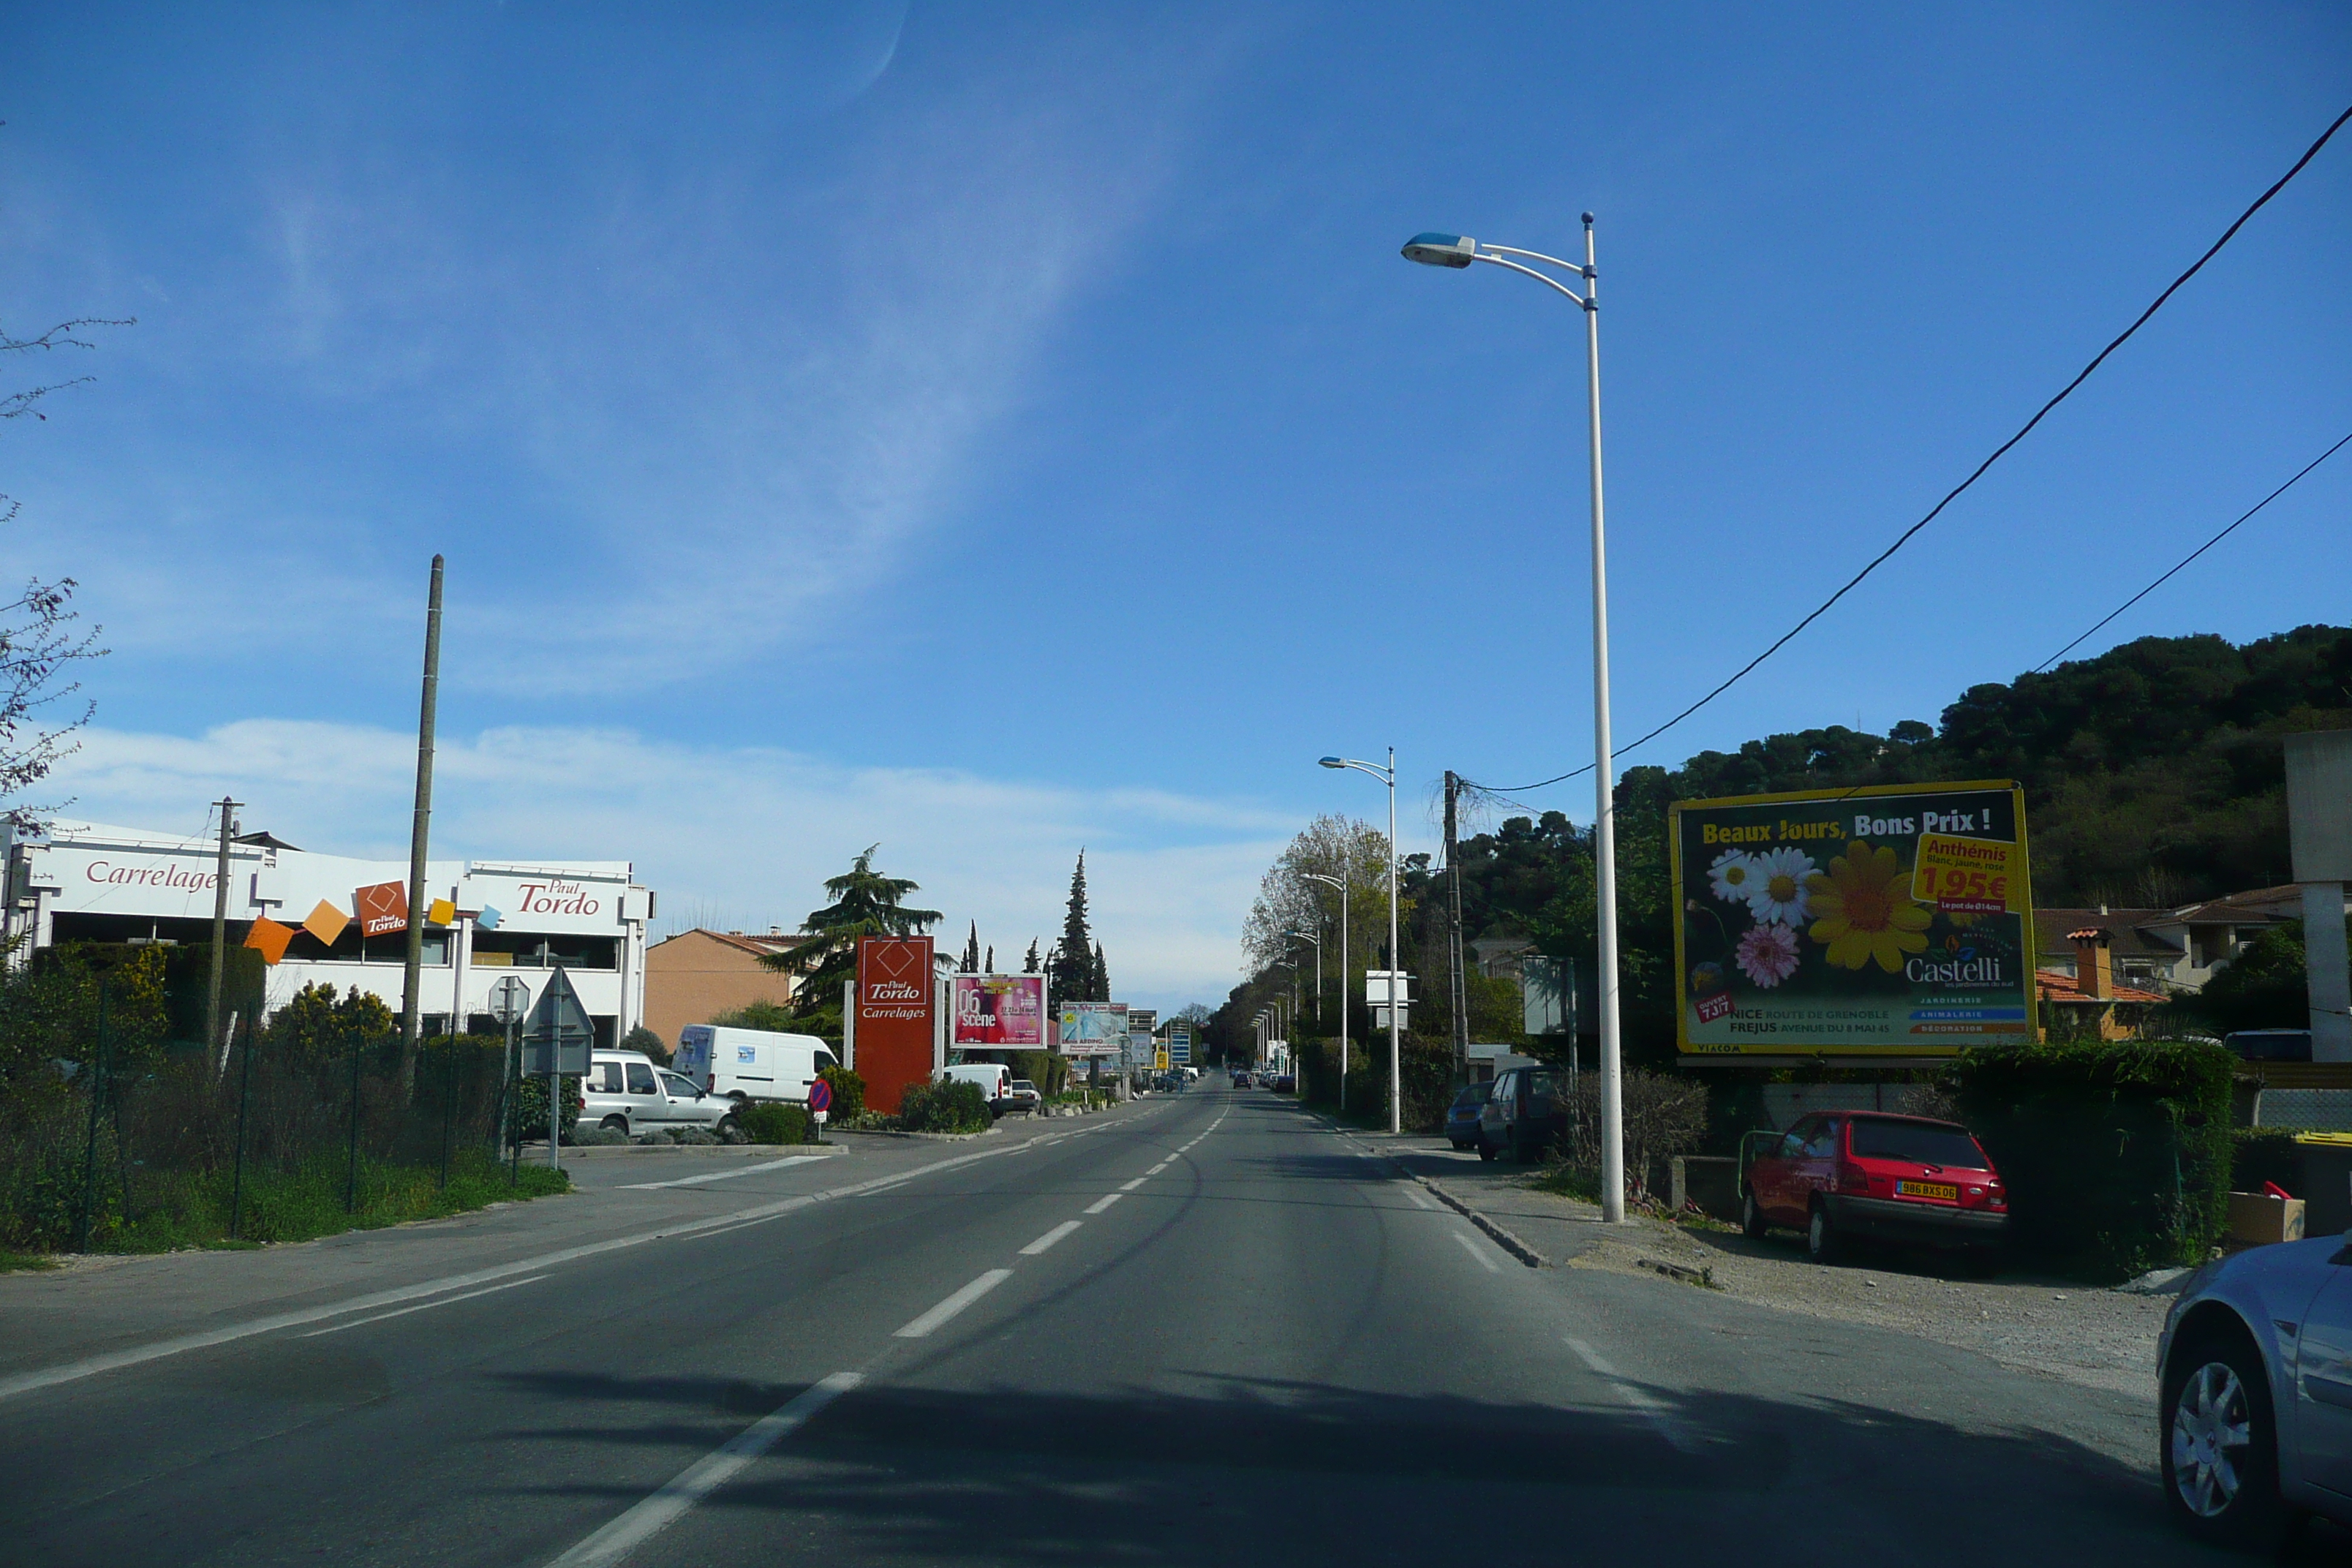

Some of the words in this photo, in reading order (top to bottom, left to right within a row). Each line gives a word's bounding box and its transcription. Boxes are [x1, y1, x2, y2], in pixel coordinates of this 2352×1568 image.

[1703, 823, 1771, 844] Beaux
[1779, 819, 1847, 840] Jours,
[1855, 815, 1915, 837] Bons
[1923, 810, 1975, 834] Prix
[1928, 840, 2007, 862] Anthémis
[1927, 854, 1953, 866] Blanc,
[1955, 859, 1983, 870] jaune,
[1985, 863, 2005, 871] rose
[549, 879, 581, 894] Paul
[1922, 866, 2008, 899] 1,95€
[516, 883, 600, 916] Tordo
[1951, 902, 1964, 911] pot
[367, 918, 406, 933] Tordo
[380, 914, 396, 923] Paul
[1906, 957, 2002, 983] Castelli
[870, 984, 920, 999] Tordo
[888, 981, 907, 989] Paul
[959, 989, 981, 1013] 06
[1699, 995, 1727, 1011] OUVERT
[863, 1007, 926, 1020] Carrelages
[1730, 1009, 1763, 1019] NICE
[1766, 1010, 1804, 1019] ROUTE
[1808, 1011, 1823, 1019] DE
[1826, 1010, 1889, 1019] GRENOBLE
[1730, 1022, 1777, 1035] FREJUS
[1780, 1024, 1825, 1033] AVENUE
[1828, 1025, 1844, 1033] DU
[1855, 1025, 1875, 1033] MAI
[1697, 1044, 1741, 1053] VIACOM
[1942, 1188, 1956, 1198] 06
